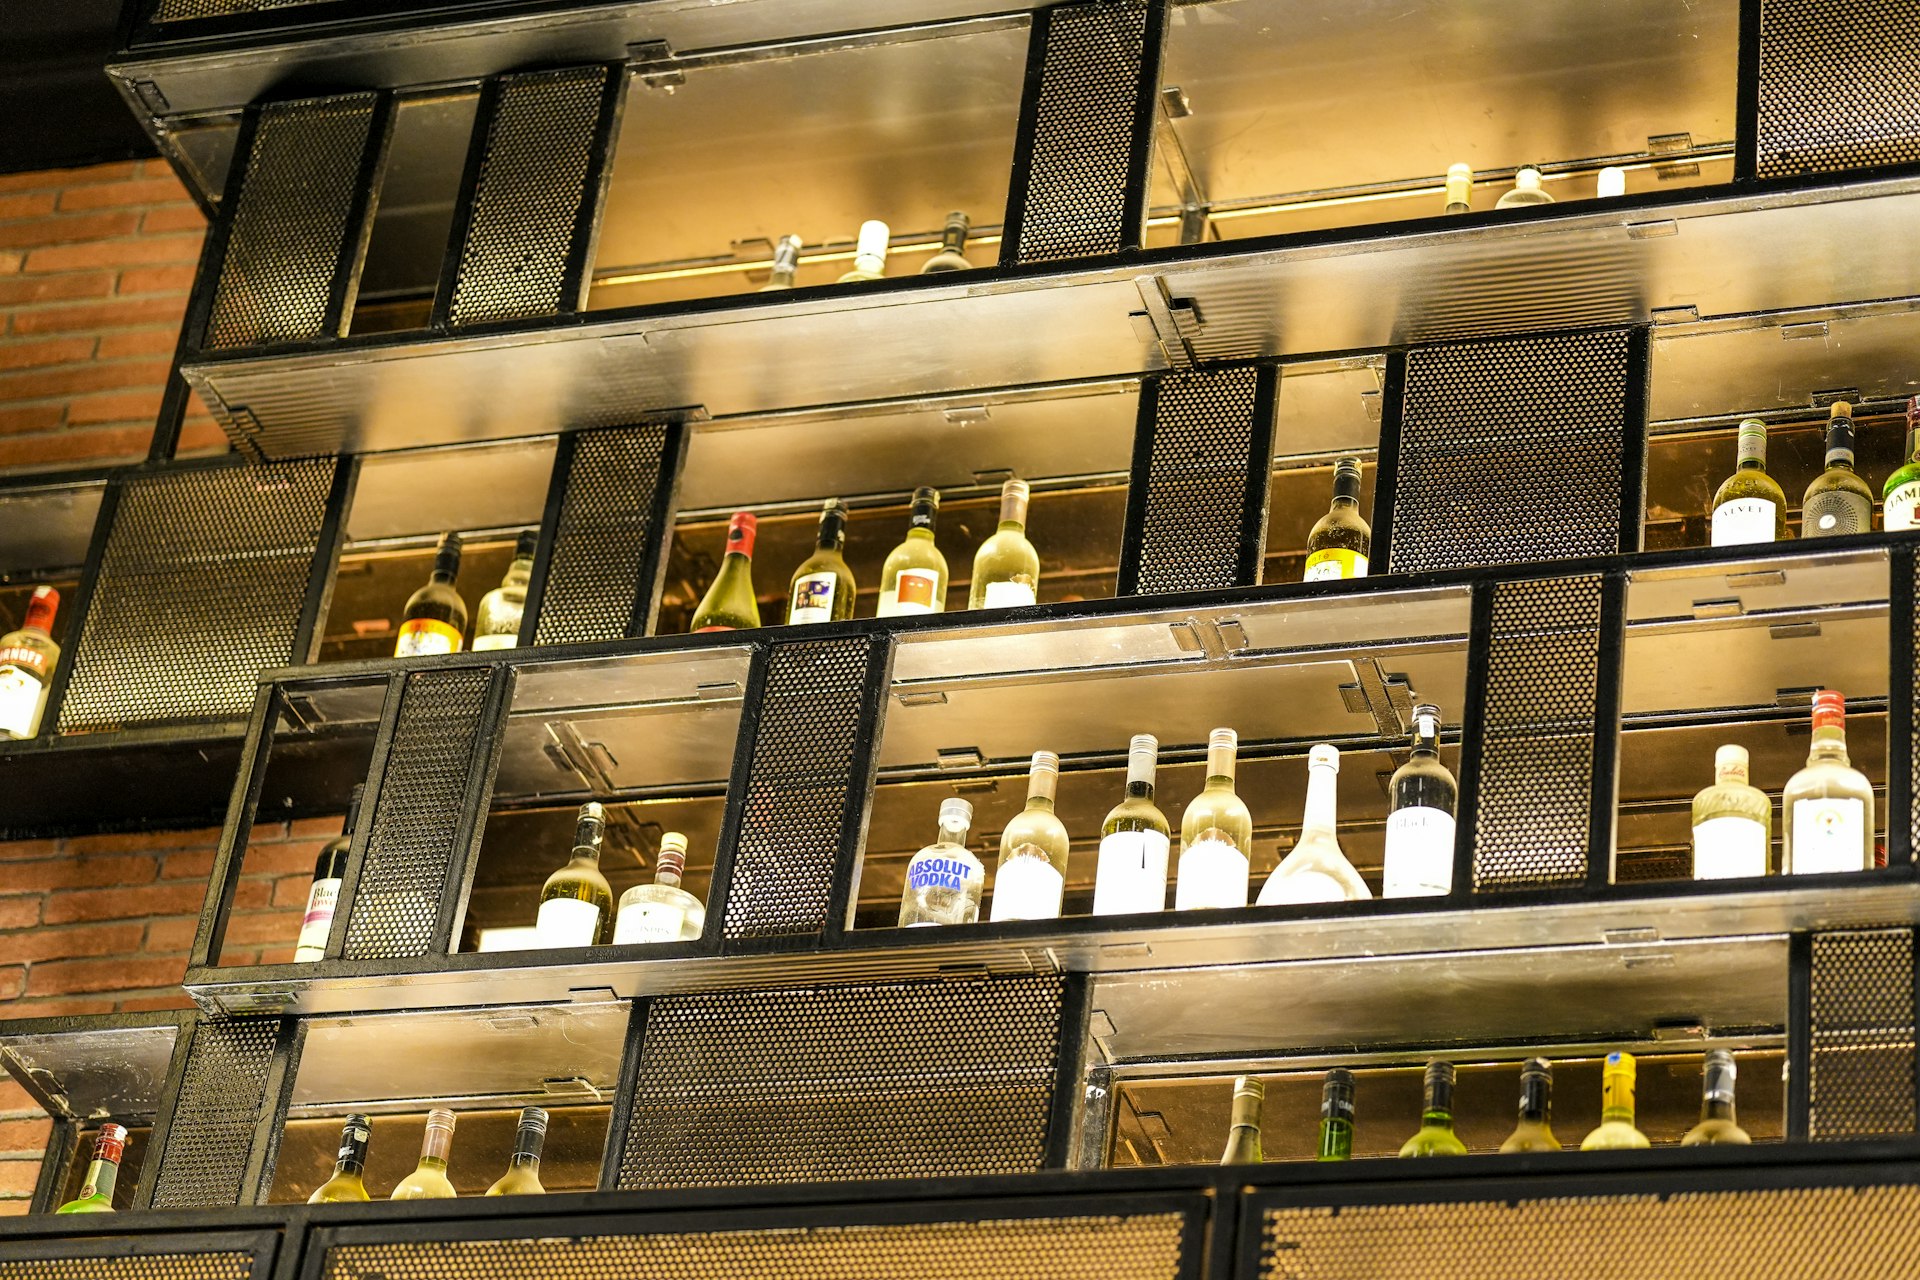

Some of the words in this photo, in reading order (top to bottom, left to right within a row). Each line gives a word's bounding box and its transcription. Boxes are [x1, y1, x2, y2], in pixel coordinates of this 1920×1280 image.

[908, 858, 971, 880] ABSOLUT
[911, 873, 961, 892] VODKA
[313, 887, 337, 899] Blac
